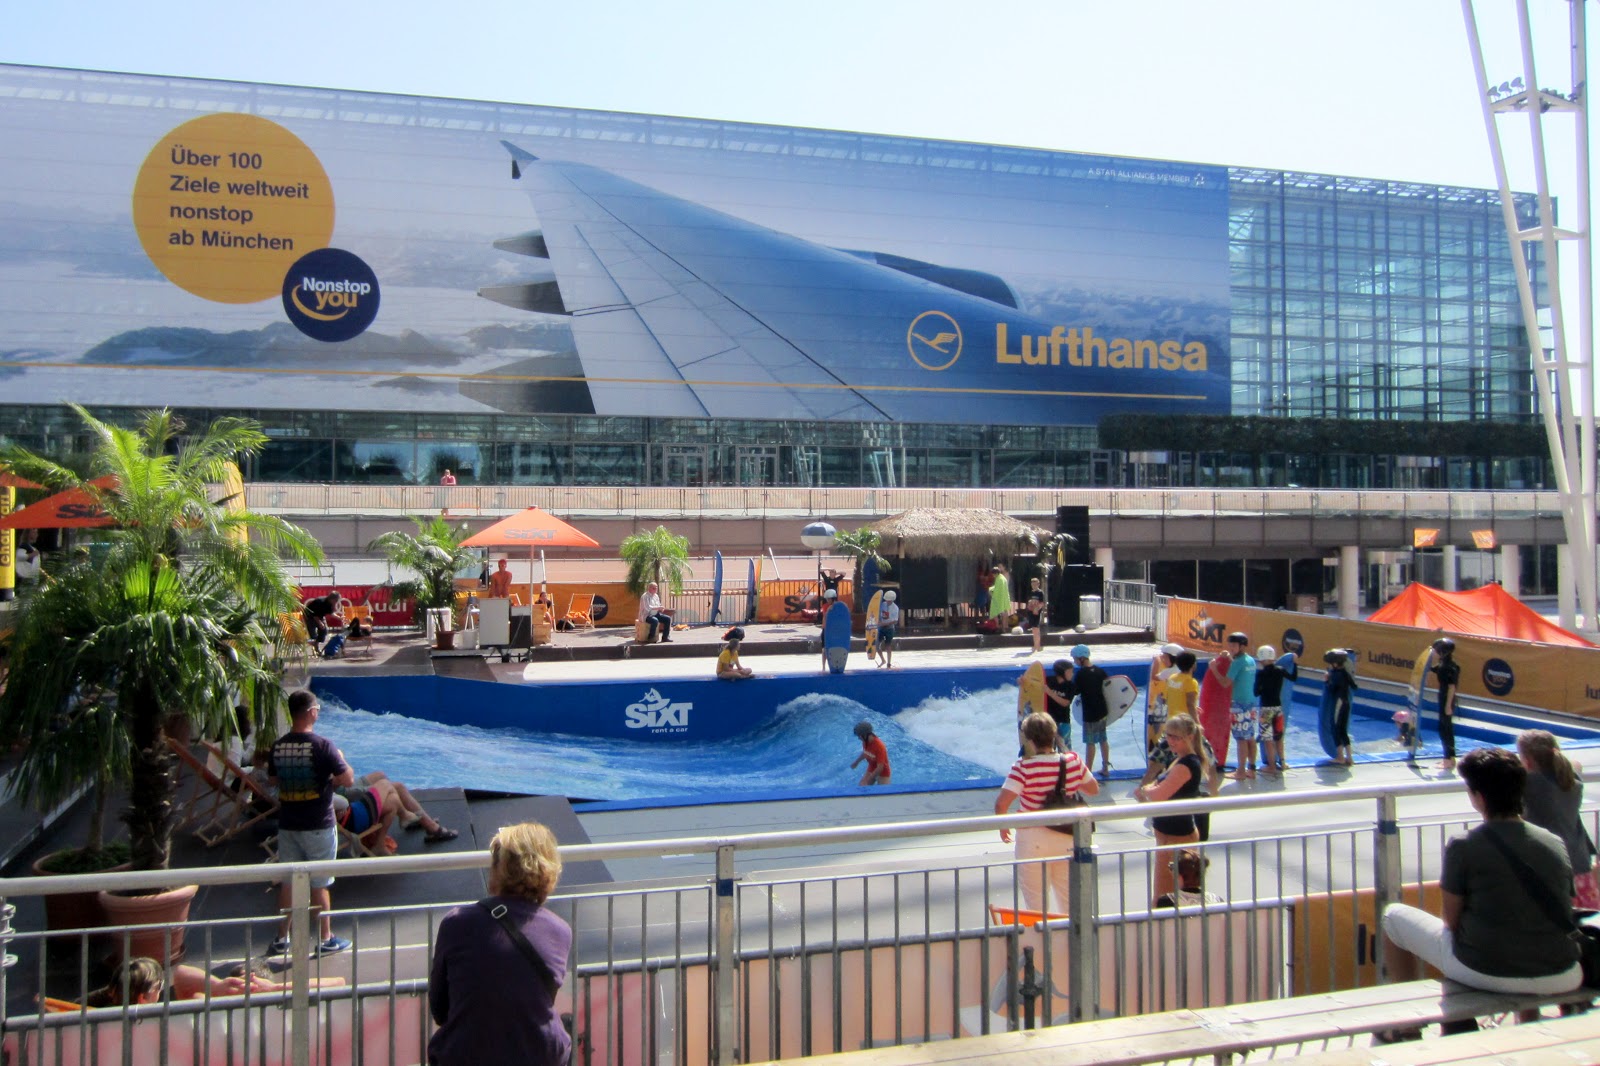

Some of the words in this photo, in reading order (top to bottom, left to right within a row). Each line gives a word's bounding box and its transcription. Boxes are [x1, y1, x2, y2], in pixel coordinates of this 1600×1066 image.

[171, 144, 221, 167] Über
[228, 152, 263, 170] 100
[1096, 168, 1116, 177] STAR
[1118, 170, 1155, 180] ALLIANCE
[1157, 173, 1191, 183] MEMBER
[170, 175, 221, 194] Ziele
[227, 180, 309, 199] weltweit
[170, 203, 254, 225] nonstop
[168, 229, 195, 247] ab
[202, 230, 294, 251] München
[303, 277, 371, 295] Nonstop
[315, 290, 358, 310] you
[996, 322, 1208, 372] Lufthansa
[362, 599, 407, 613] Audi
[1368, 651, 1415, 671] Lufthans
